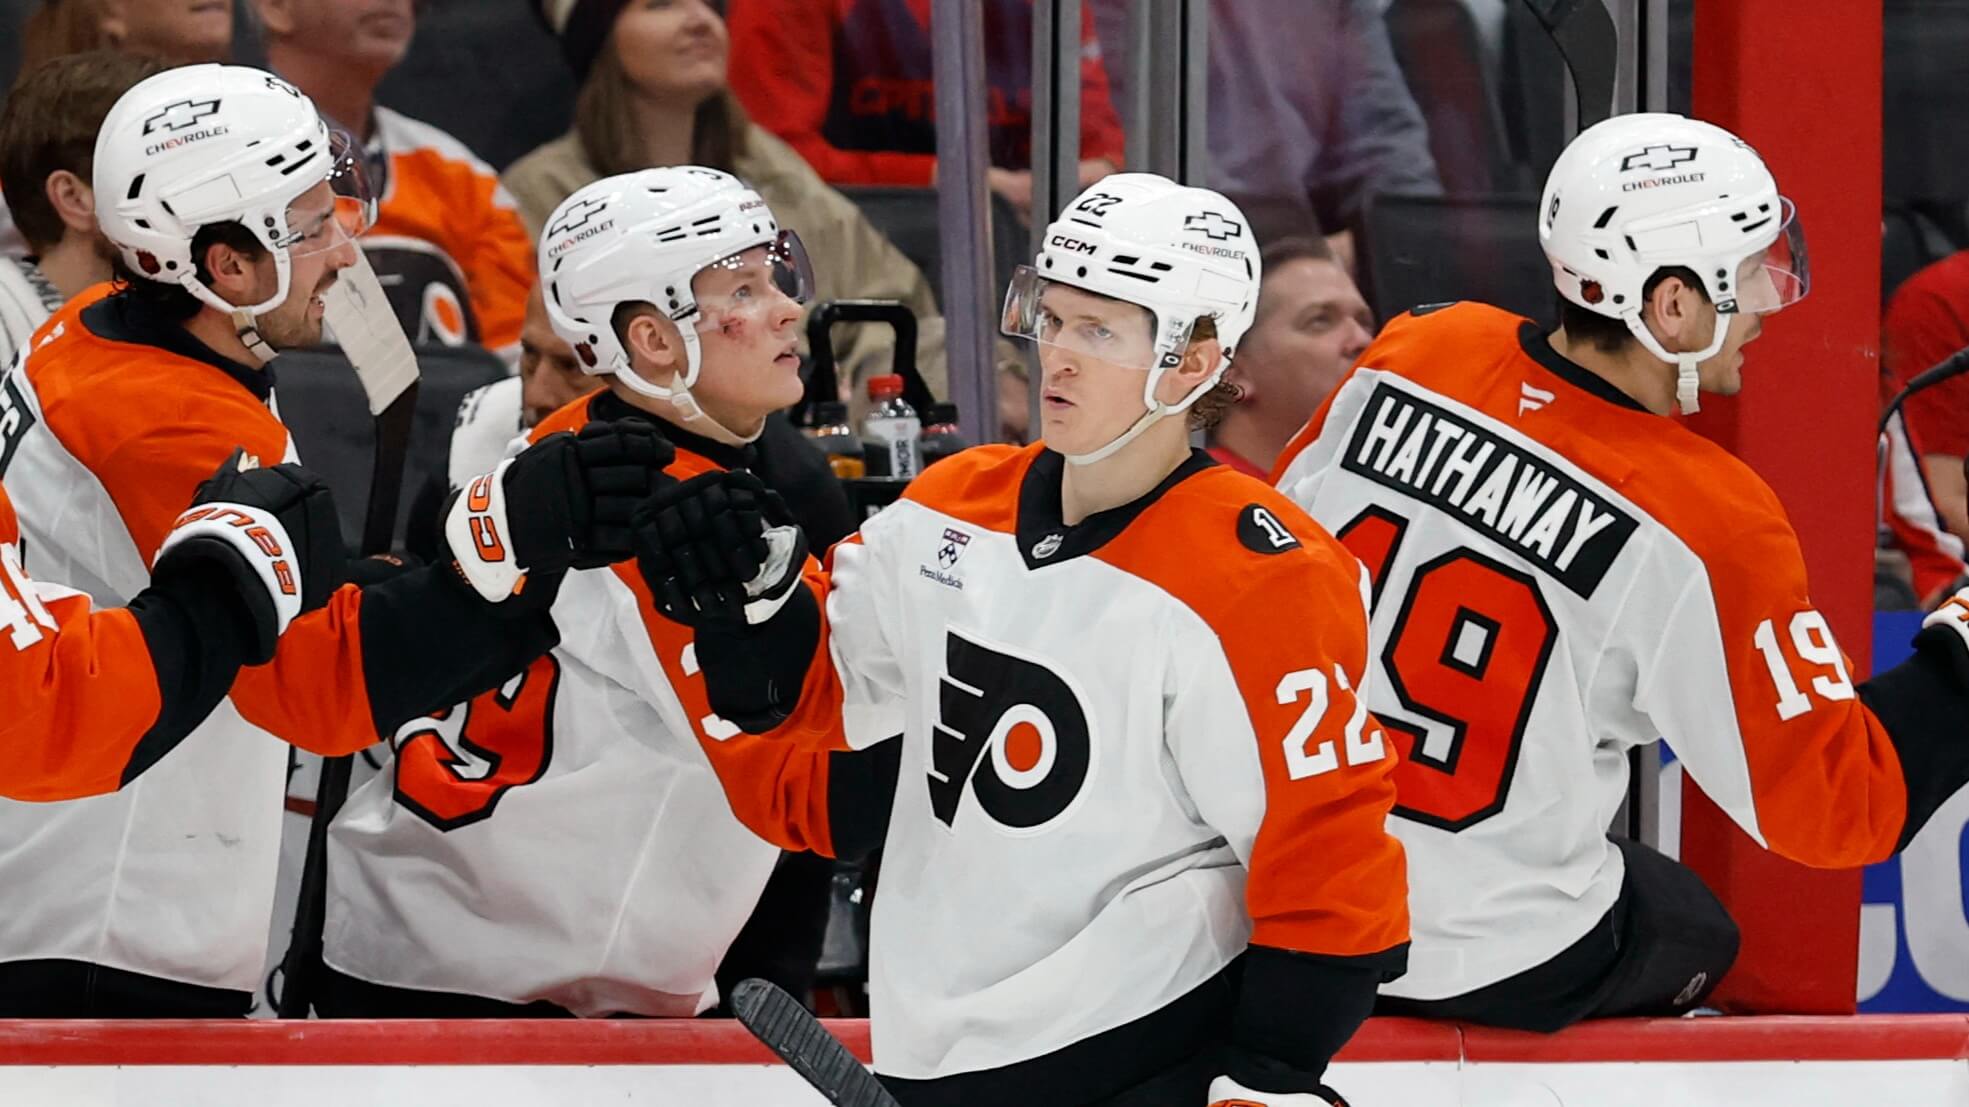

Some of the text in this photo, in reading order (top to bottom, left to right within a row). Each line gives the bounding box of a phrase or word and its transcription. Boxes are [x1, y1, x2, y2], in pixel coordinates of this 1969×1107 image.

[146, 125, 230, 156] CHEVROLET
[1622, 173, 1706, 193] CHEVROLET
[1076, 193, 1123, 217] 22
[548, 218, 615, 258] CHEVROLET
[1051, 235, 1098, 256] CCM
[1181, 242, 1246, 261] CHEVROLET
[1356, 395, 1617, 573] HATHAWAY
[1253, 508, 1297, 548] 1
[1326, 504, 1560, 834] 19
[1754, 609, 1856, 721] 19
[1275, 662, 1386, 781] 22
